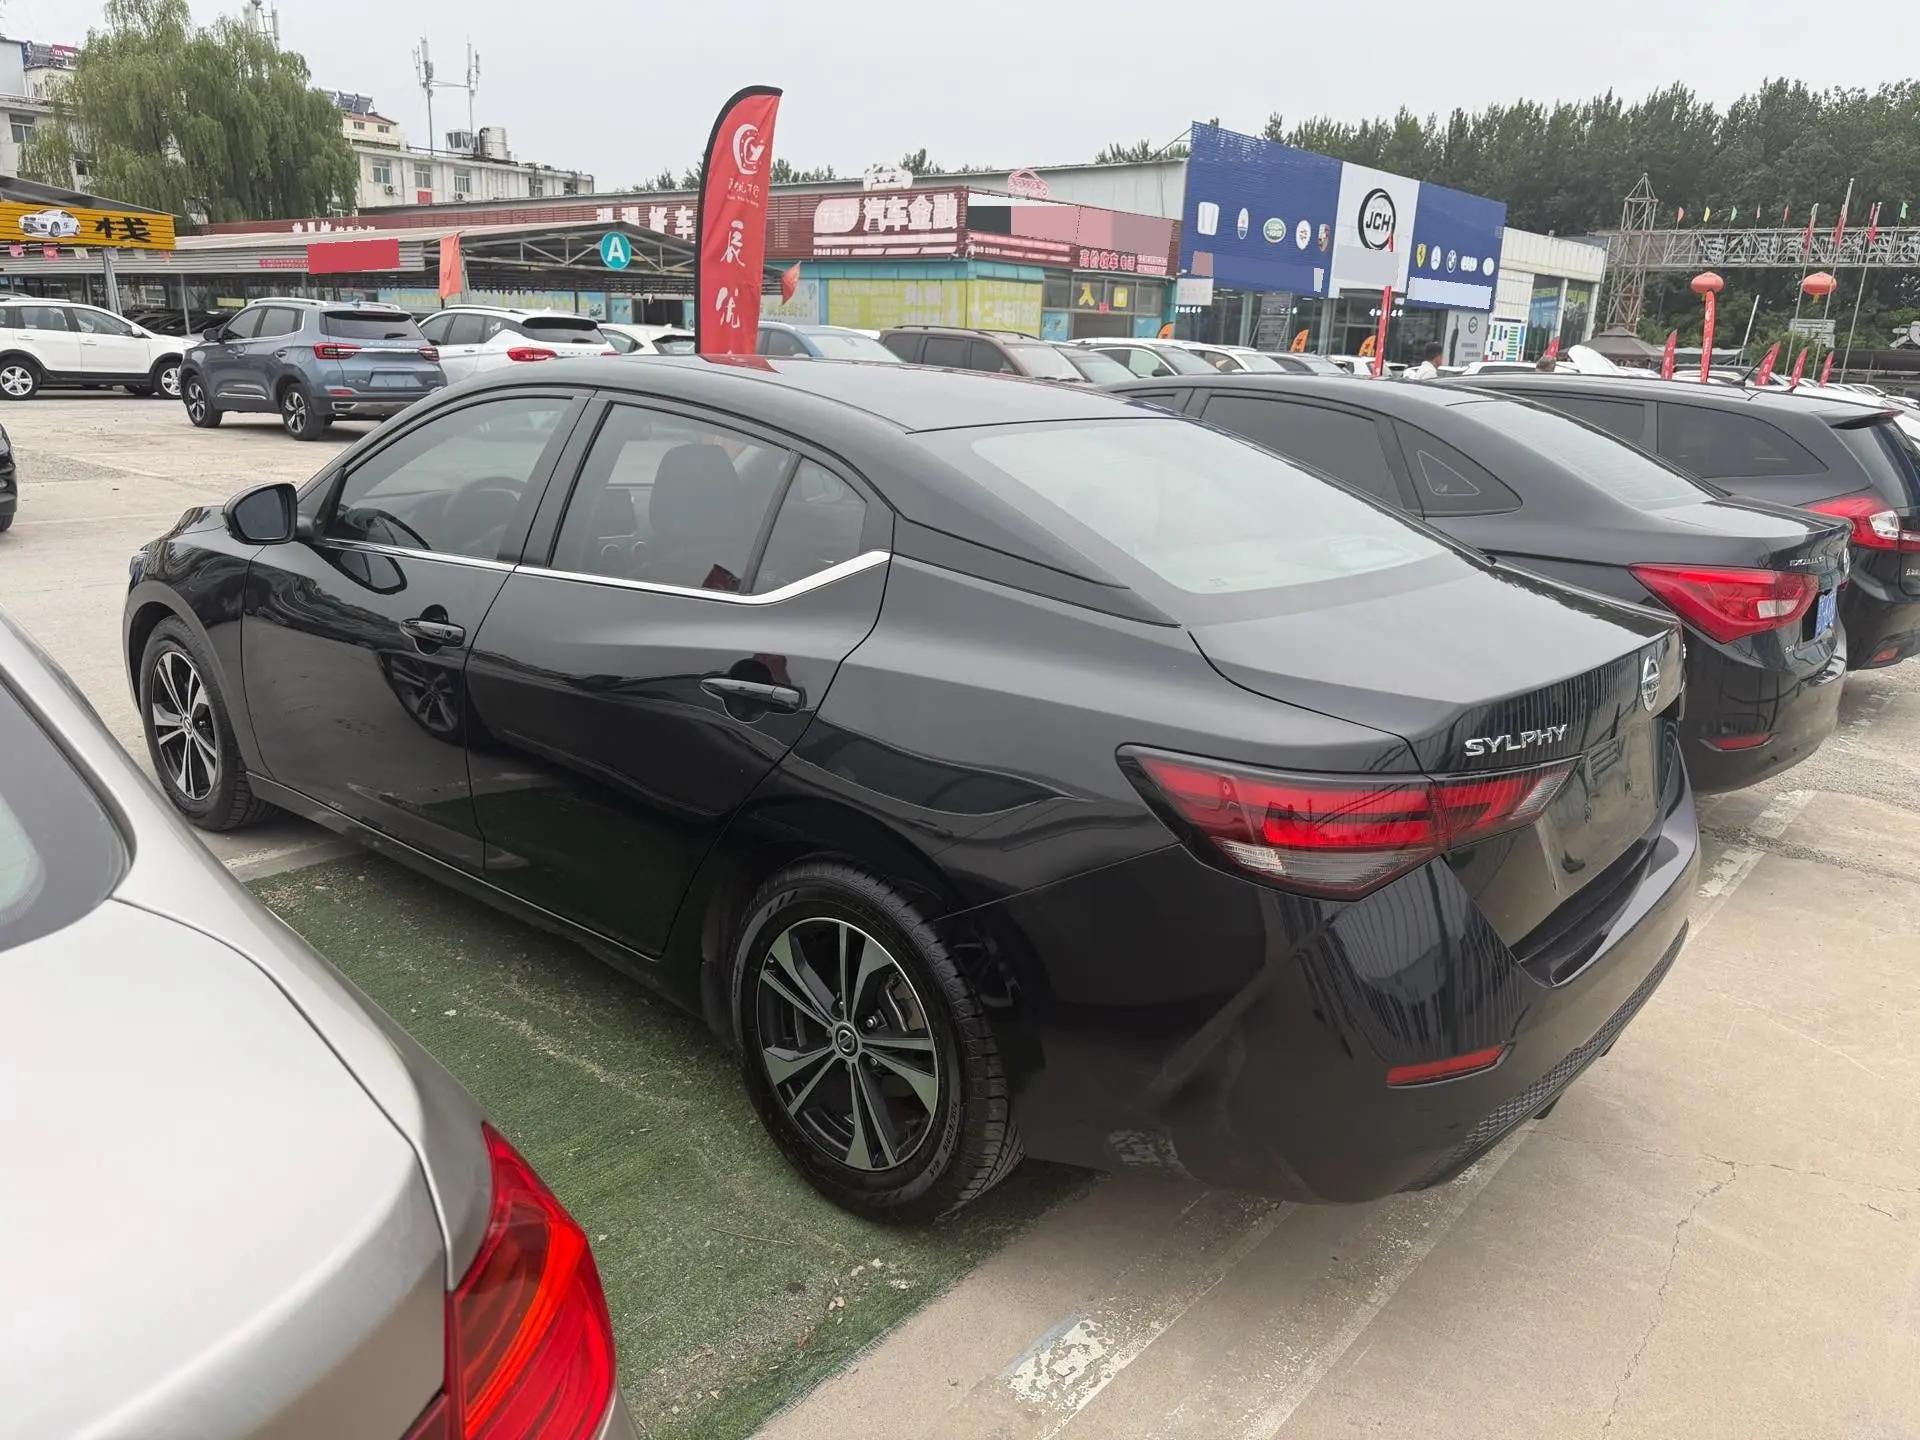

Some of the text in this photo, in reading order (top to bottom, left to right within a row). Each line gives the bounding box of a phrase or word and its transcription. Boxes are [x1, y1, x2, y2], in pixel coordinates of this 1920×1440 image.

[863, 193, 958, 232] 汽车金融
[1366, 211, 1392, 231] JCH
[95, 217, 151, 242] 栈
[607, 237, 626, 262] A
[1464, 724, 1568, 757] SYLPHY
